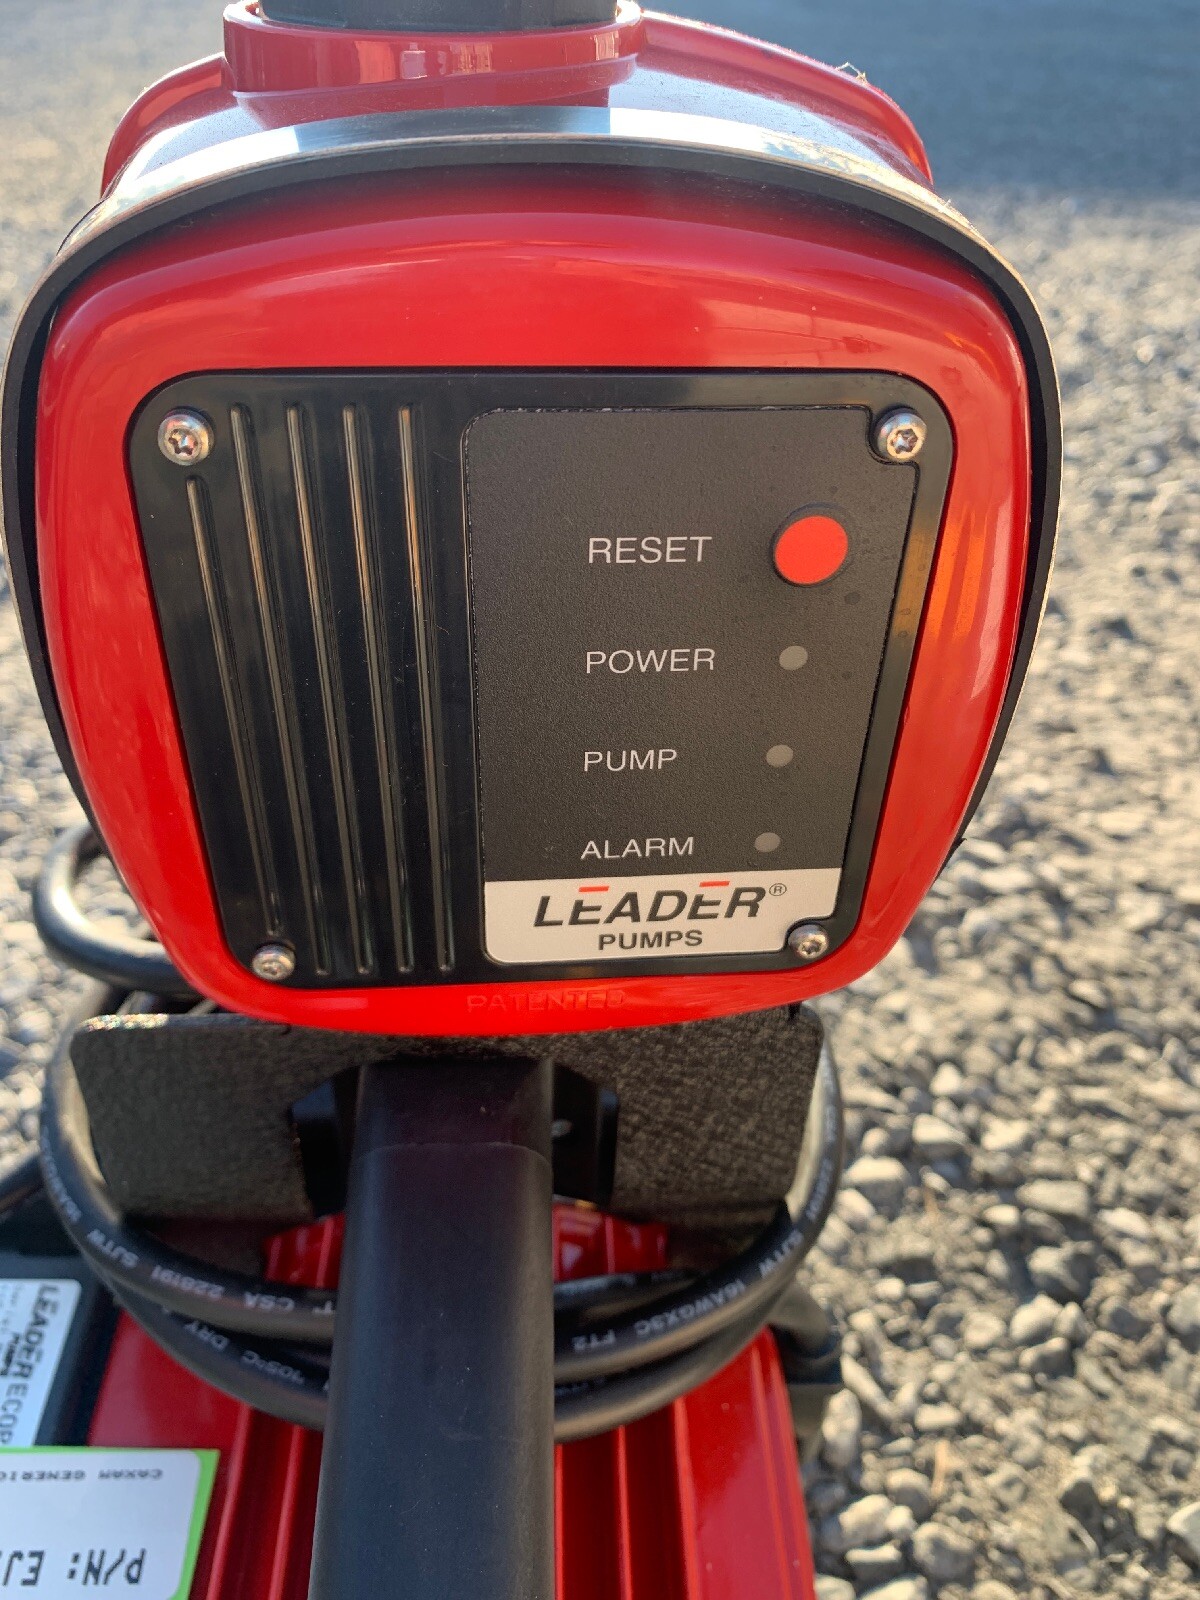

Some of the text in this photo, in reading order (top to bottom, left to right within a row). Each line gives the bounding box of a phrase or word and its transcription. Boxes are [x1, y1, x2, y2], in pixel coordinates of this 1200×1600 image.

[588, 535, 713, 564] RESET
[586, 647, 716, 674] POWER
[582, 748, 678, 772] PUMP
[580, 836, 695, 861] ALARM
[598, 929, 703, 951] PUMPS
[466, 988, 626, 1012] PATENTED
[13, 1283, 60, 1379] LEADER
[0, 1548, 148, 1587] P/N: EJ
